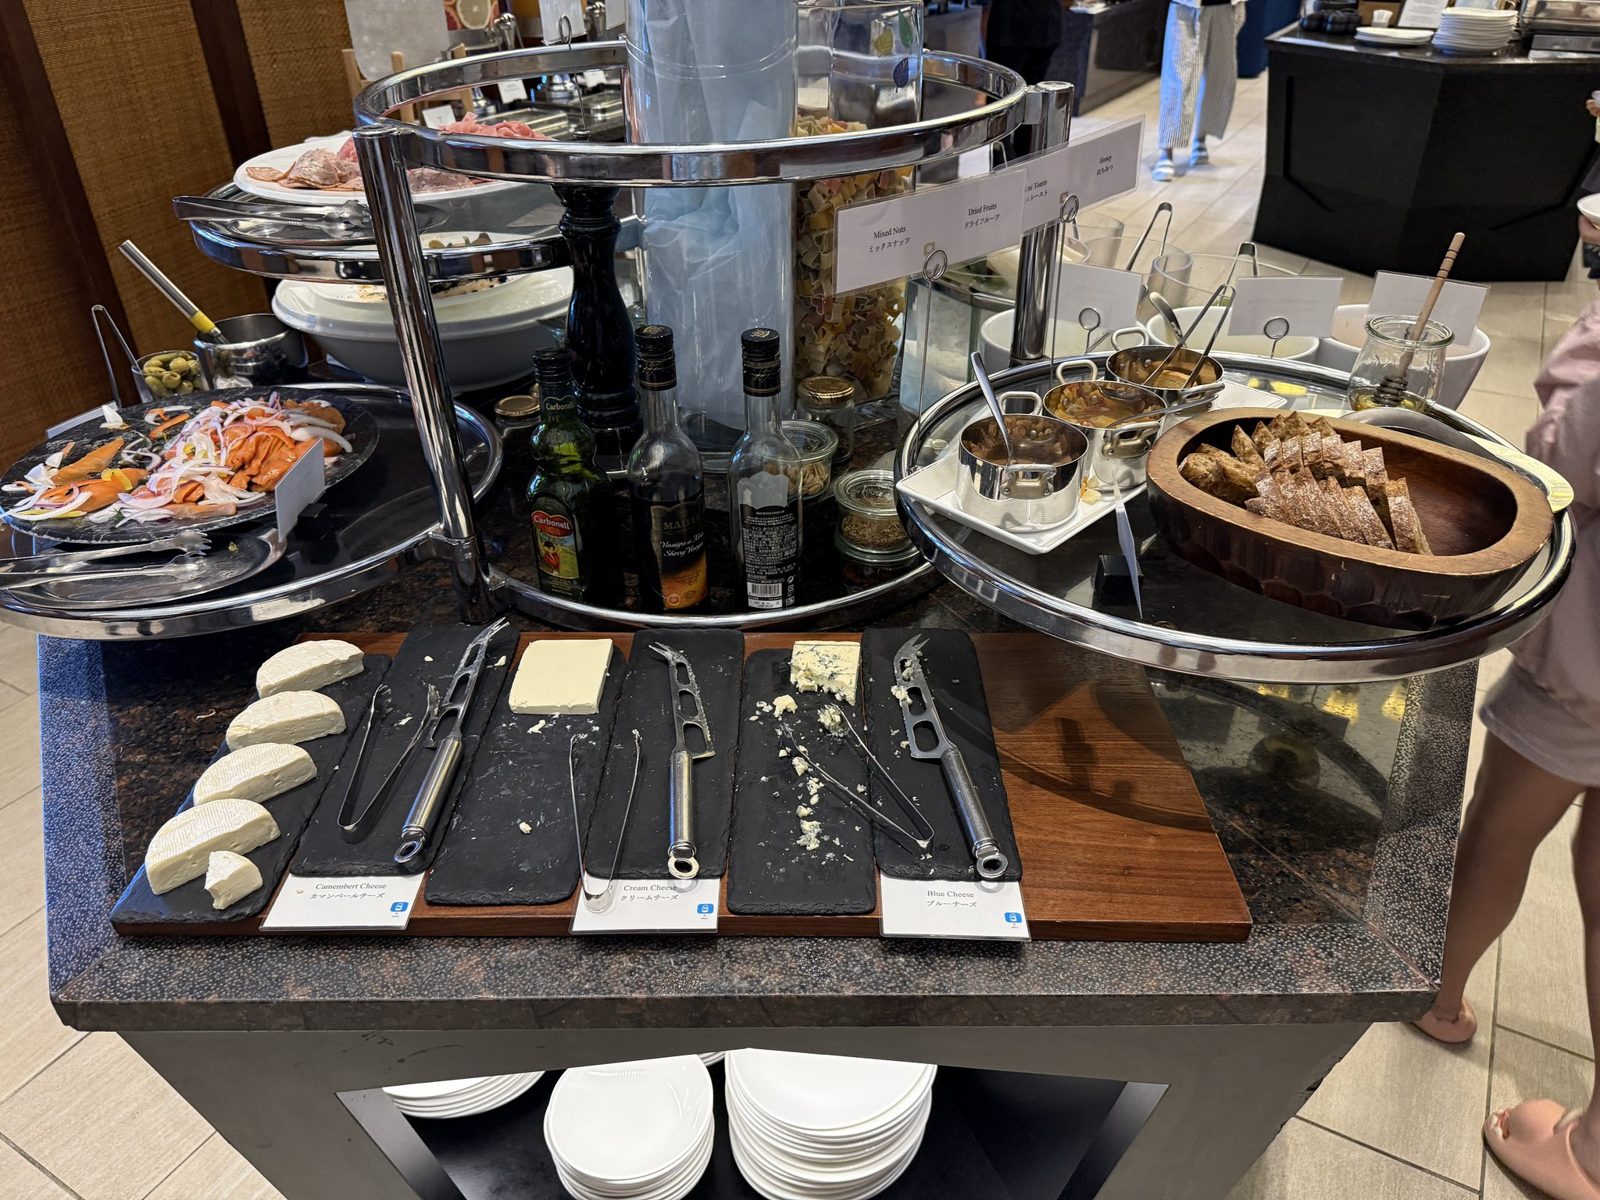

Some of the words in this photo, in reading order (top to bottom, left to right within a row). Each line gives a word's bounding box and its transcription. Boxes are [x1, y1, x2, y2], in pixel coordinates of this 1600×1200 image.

[1100, 156, 1112, 164] Honey
[968, 205, 982, 216] Dried
[983, 203, 997, 212] Fruits
[873, 227, 892, 239] Mixed
[893, 226, 907, 235] Nuts
[869, 237, 910, 253] ミックスナッツ
[533, 515, 571, 530] Carbonell
[623, 884, 648, 892] Cream
[620, 894, 679, 902] クリームチーズ
[927, 890, 945, 898] Blue
[946, 890, 974, 898] Cheese
[927, 900, 977, 908] ブルーチーズ
